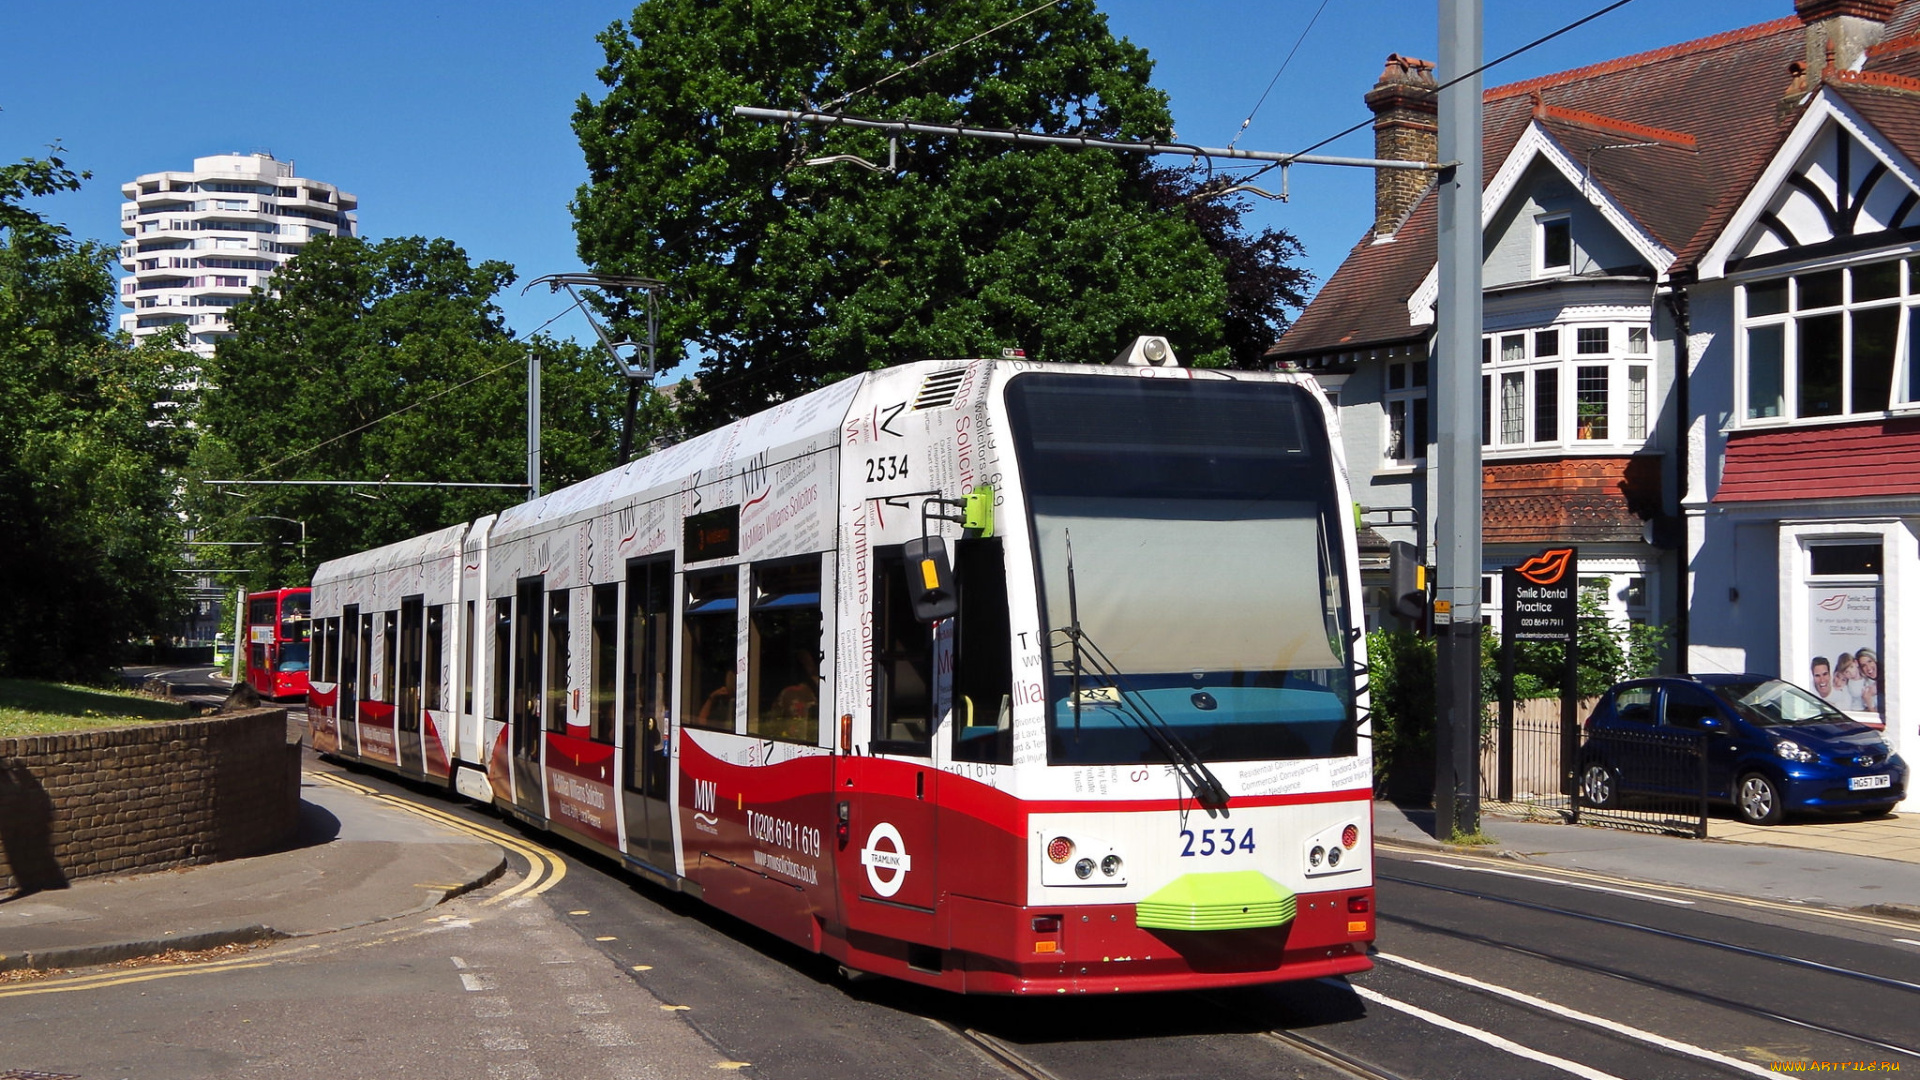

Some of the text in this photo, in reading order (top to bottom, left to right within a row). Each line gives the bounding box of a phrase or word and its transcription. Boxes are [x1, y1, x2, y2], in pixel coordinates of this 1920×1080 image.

[866, 454, 909, 483] 2534
[789, 483, 818, 517] Solicitors
[853, 515, 869, 605] Williams
[1516, 586, 1568, 599] Smile Dental
[1516, 600, 1553, 612] Practice
[1521, 618, 1564, 627] 020 8649 7911
[1017, 631, 1028, 650] T
[1239, 763, 1274, 779] Residential
[1241, 776, 1279, 792] Commercial
[1279, 762, 1320, 782] Conveyancing
[1329, 763, 1352, 777] Landlord
[1331, 775, 1353, 789] Personal
[1854, 777, 1873, 788] HG57
[694, 778, 717, 813] MW
[747, 809, 753, 837] T
[754, 812, 774, 844] 0208
[775, 818, 792, 849] 619
[794, 823, 799, 851] 1
[802, 825, 820, 858] 619
[1179, 827, 1256, 857] 2534
[753, 849, 819, 886] www.mwsolicitors.co.uk
[871, 853, 901, 866] TRAMLINK
